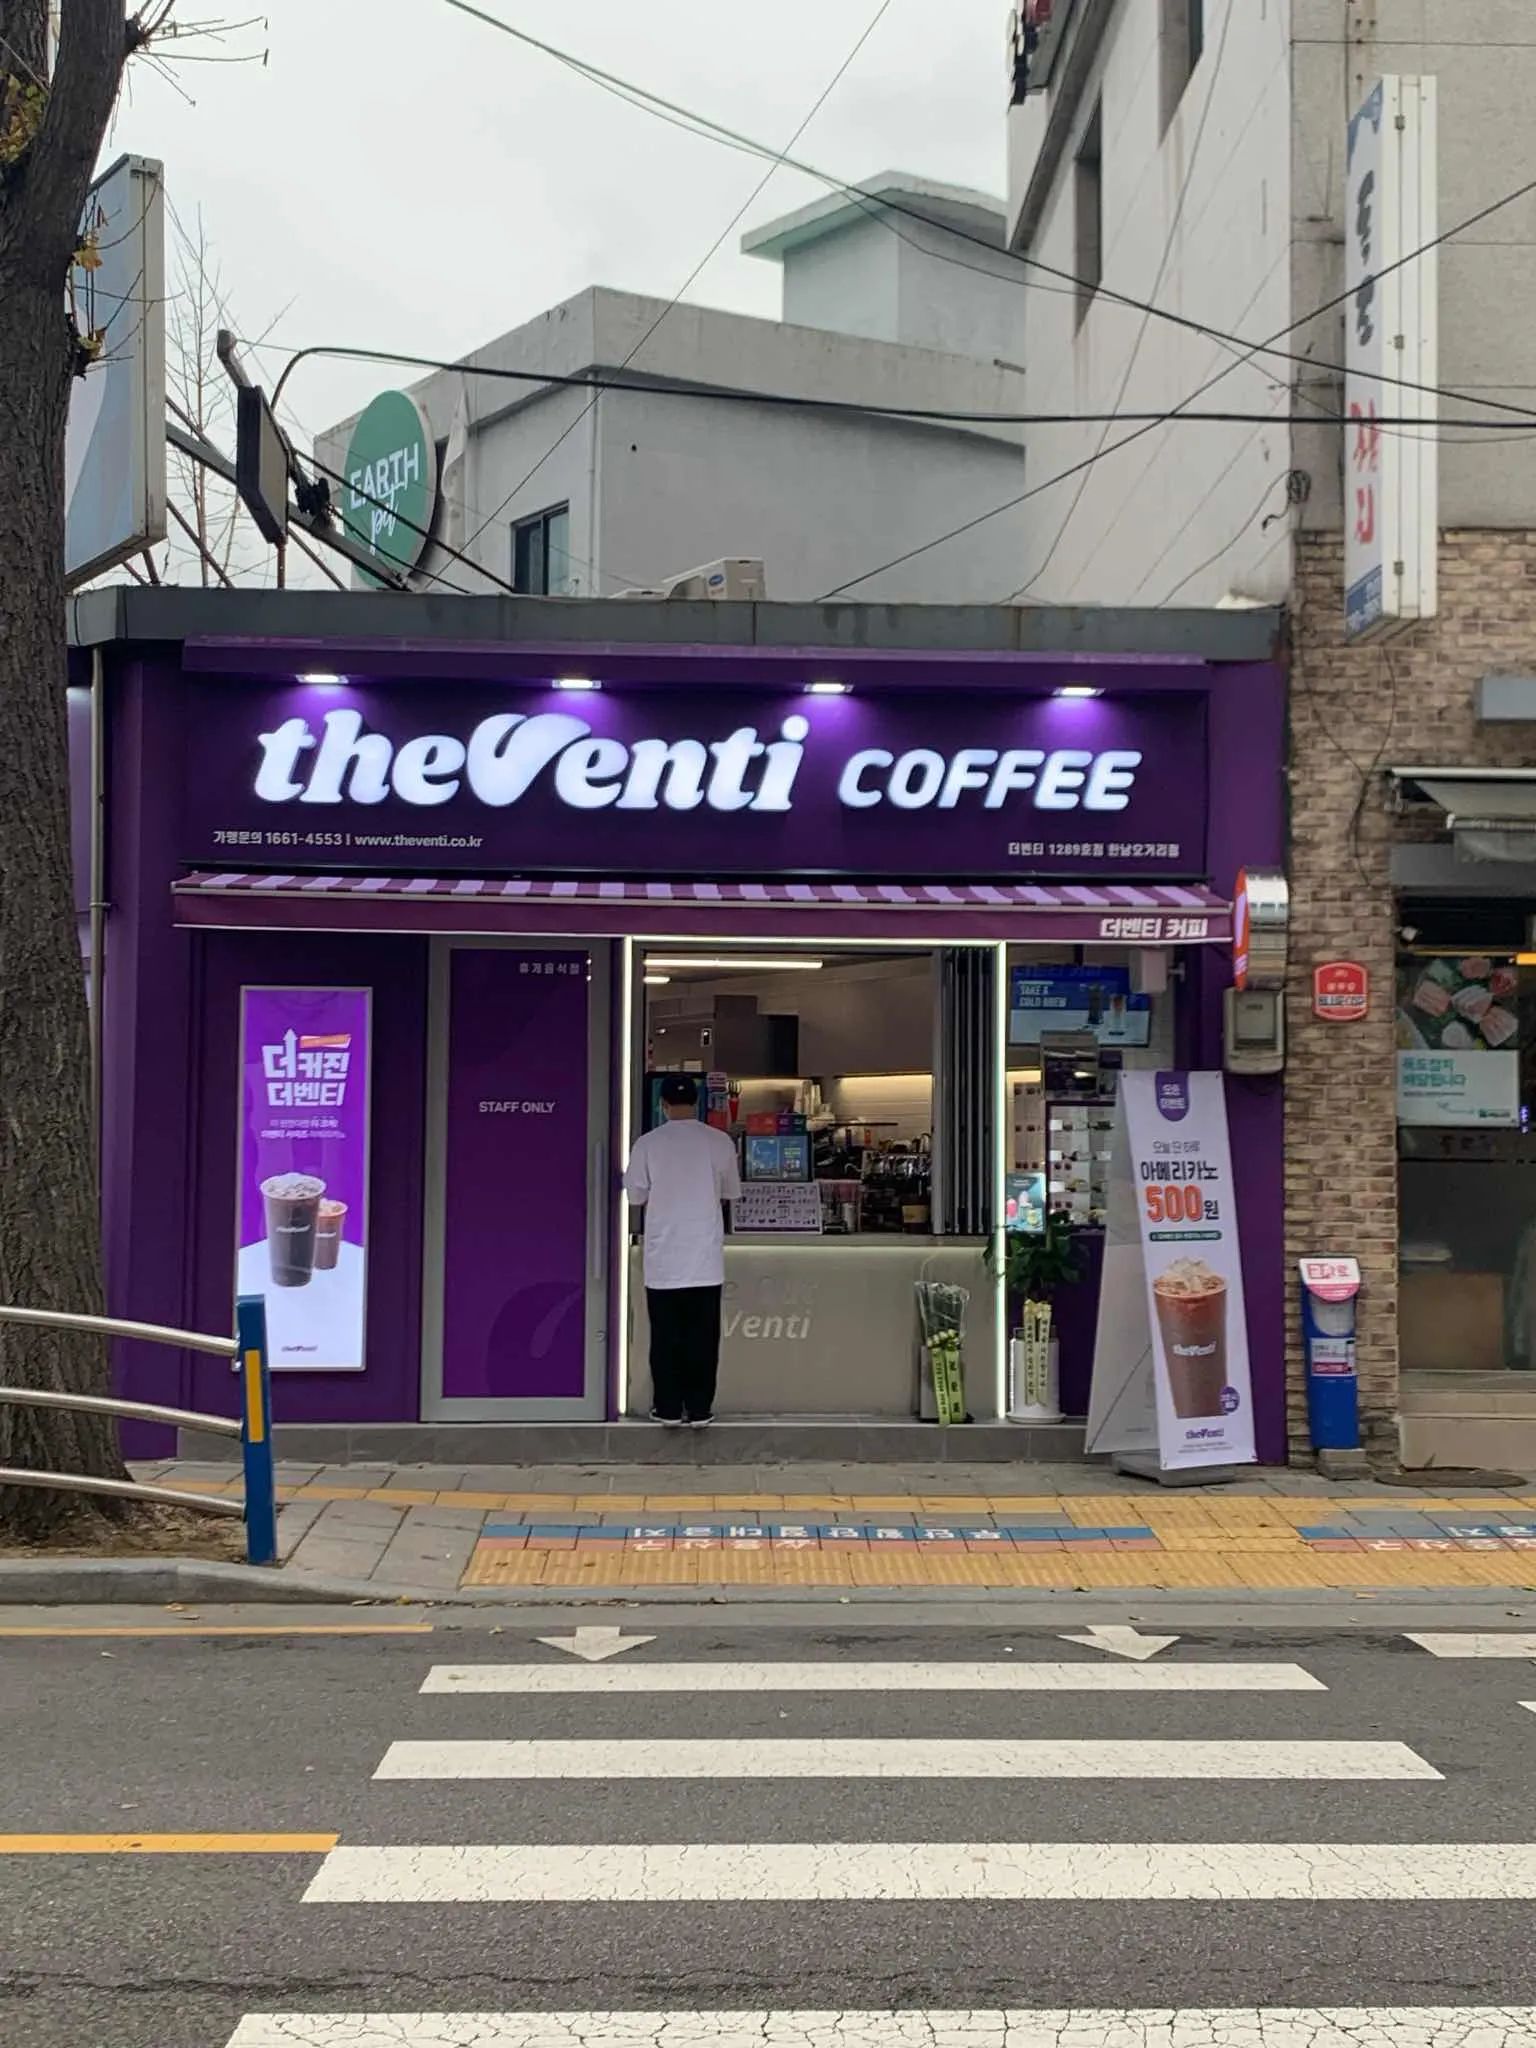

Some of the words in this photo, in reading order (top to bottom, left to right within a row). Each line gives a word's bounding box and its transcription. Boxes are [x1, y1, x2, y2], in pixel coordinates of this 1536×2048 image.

[350, 442, 419, 510] EARTH
[254, 708, 810, 811] theVenti
[838, 748, 1143, 811] COFFEE
[213, 830, 263, 845] 가맹문의
[265, 831, 343, 847] 1661-4553
[353, 833, 483, 849] www.theventi.co.kr
[1008, 842, 1044, 856] 더벤티
[1100, 918, 1161, 938] 더벤티
[1164, 919, 1208, 938] 커피
[519, 963, 580, 975] 휴게음식점
[261, 1029, 351, 1080] 더커진
[267, 1082, 346, 1106] 더벤티
[479, 1101, 519, 1113] STAFF
[521, 1101, 556, 1114] ONLY
[1140, 1160, 1219, 1182] 아메리카노
[1144, 1184, 1220, 1223] 500원
